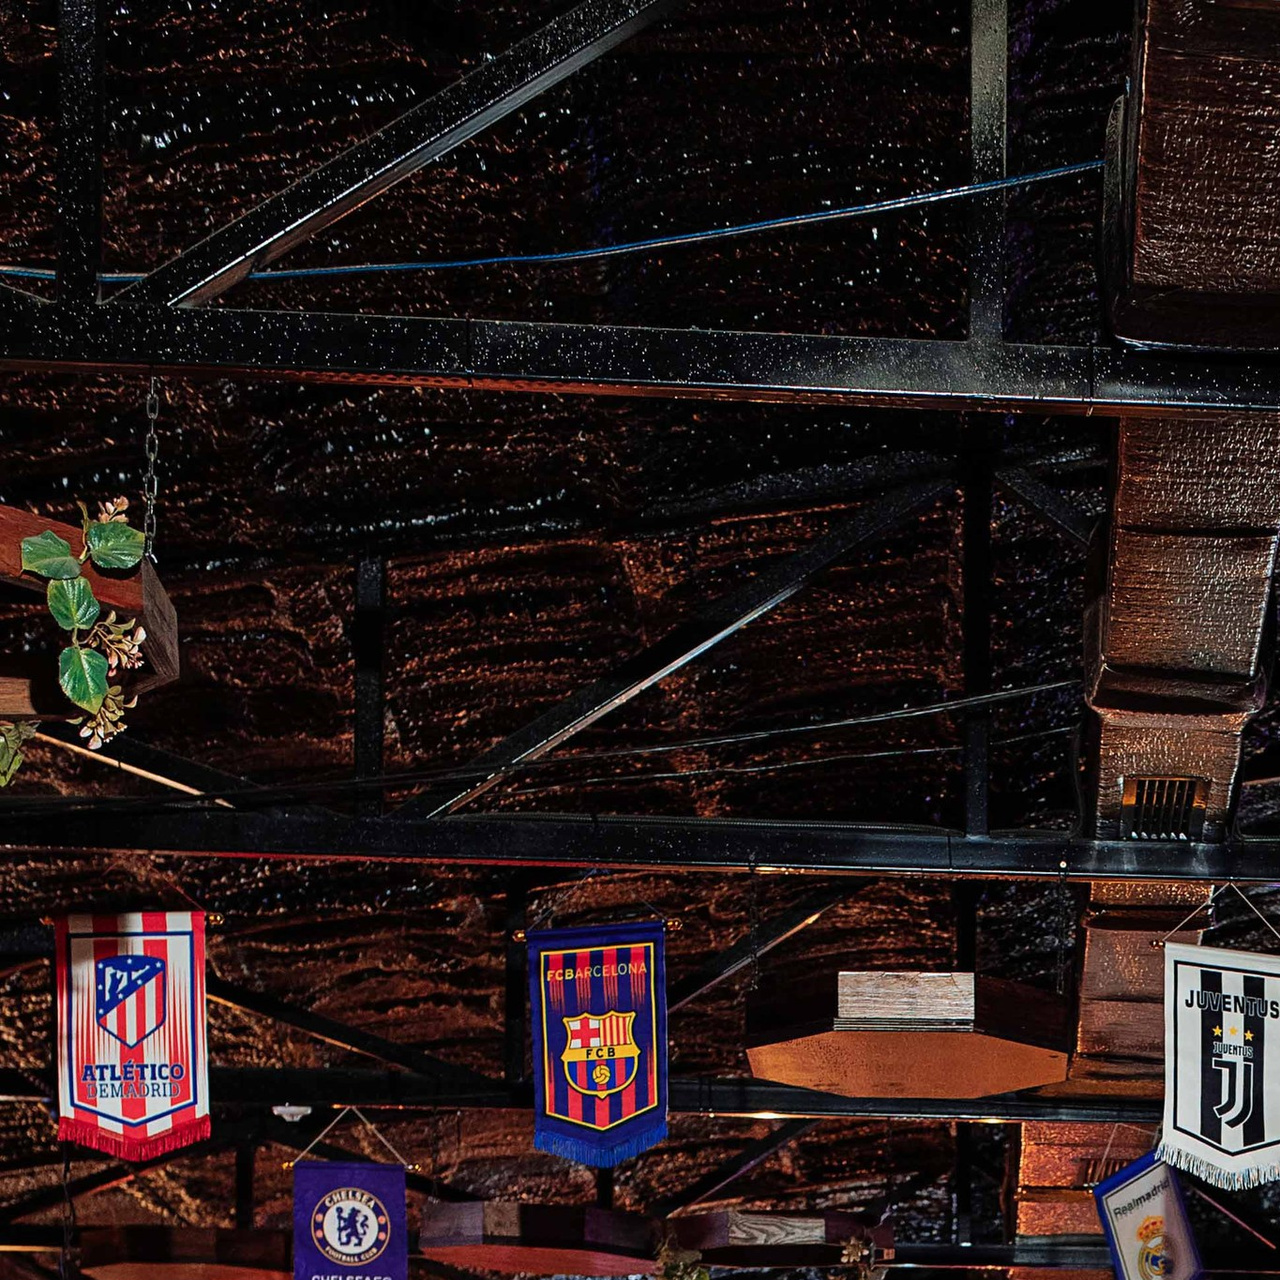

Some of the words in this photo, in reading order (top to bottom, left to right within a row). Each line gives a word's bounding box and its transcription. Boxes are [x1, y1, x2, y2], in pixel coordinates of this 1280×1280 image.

[1185, 990, 1280, 1019] JUVENTUS
[586, 1048, 616, 1059] FCB
[1213, 1041, 1253, 1058] JUVENTUS
[82, 1060, 184, 1081] ATLÉTICO
[325, 1190, 375, 1209] CHELSEA
[325, 1246, 359, 1262] FOOTBALL
